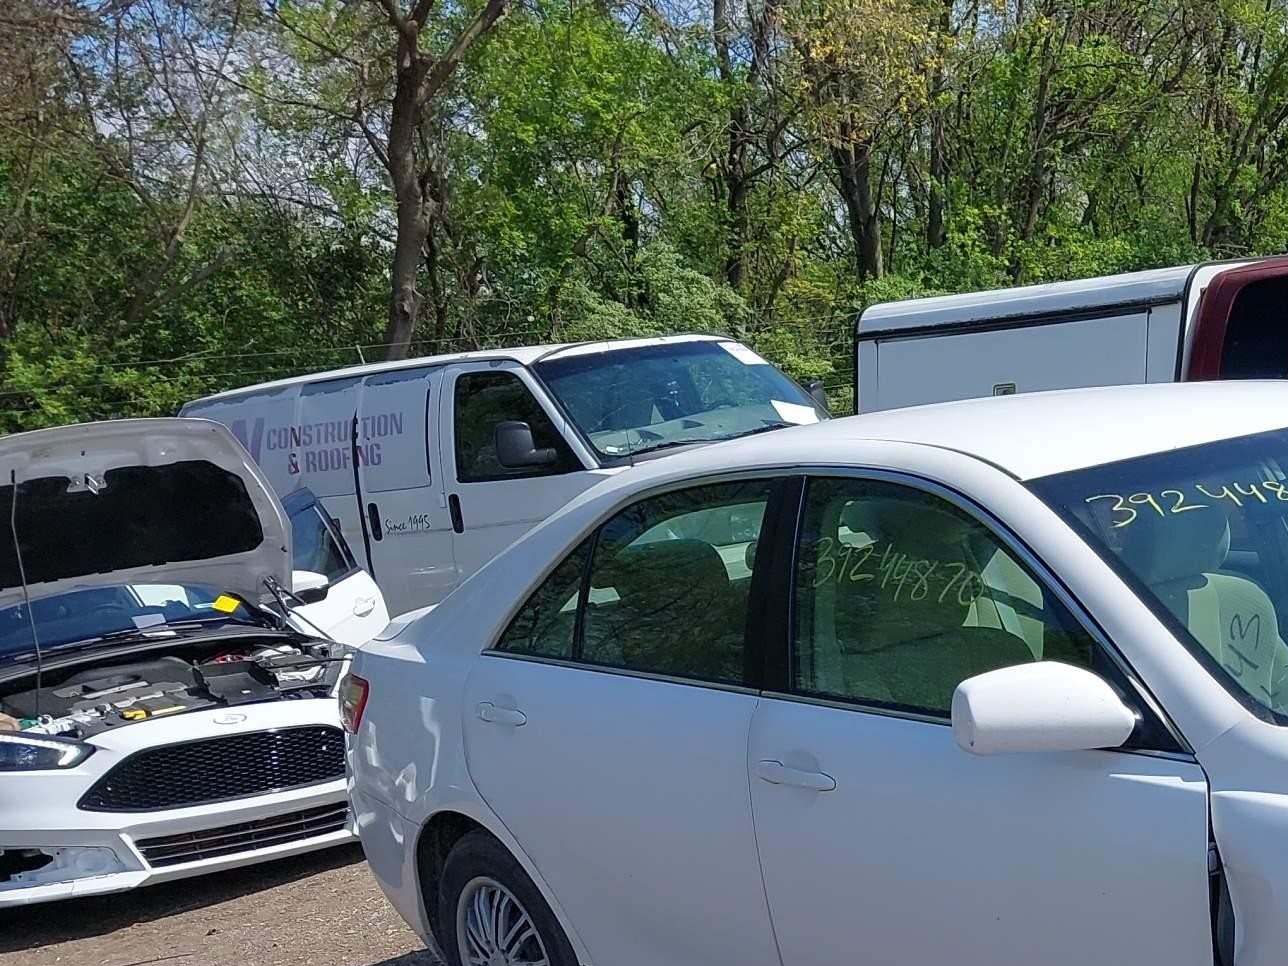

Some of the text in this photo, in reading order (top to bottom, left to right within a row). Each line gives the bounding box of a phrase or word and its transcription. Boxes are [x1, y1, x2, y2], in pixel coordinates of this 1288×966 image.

[266, 412, 403, 451] CONSTRUTION
[288, 453, 300, 475] &
[811, 536, 985, 606] 39244870
